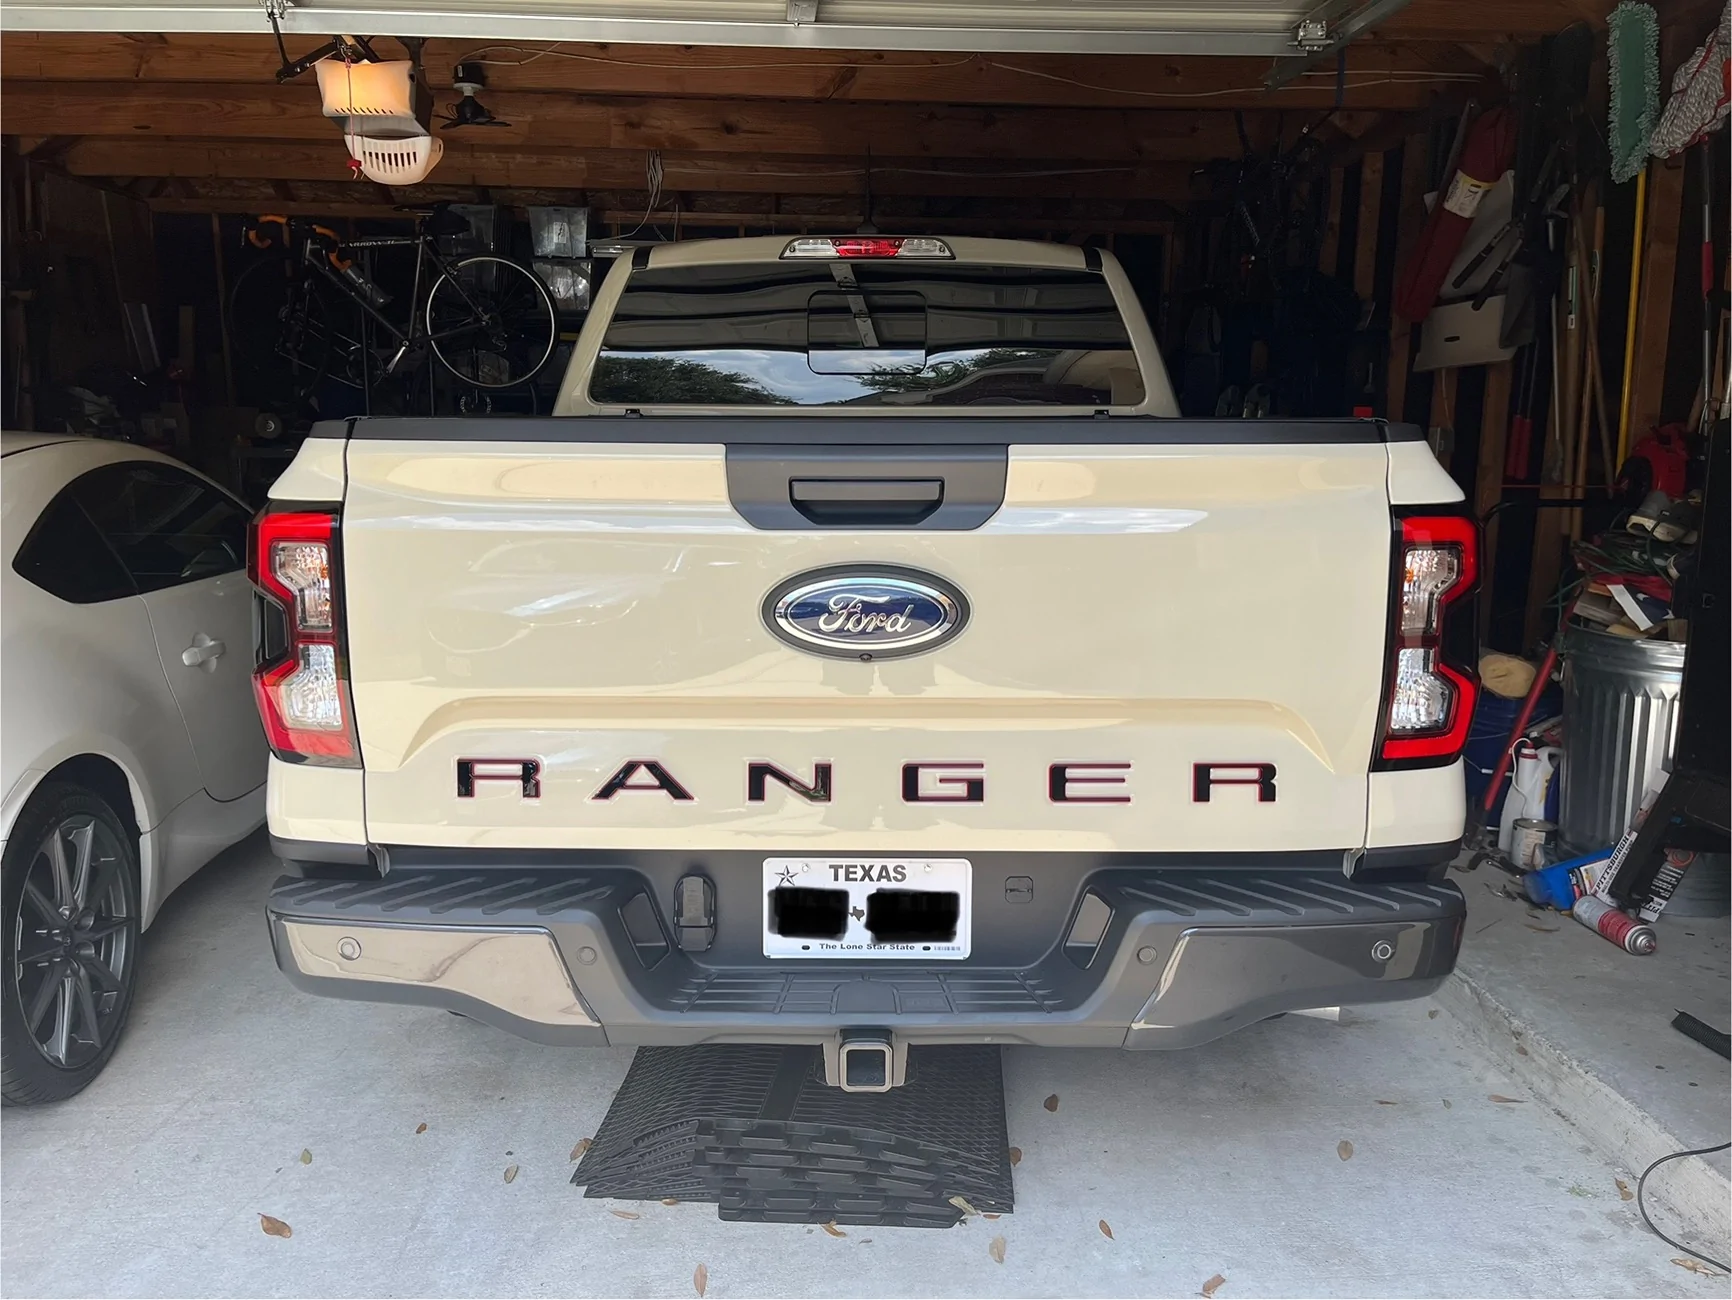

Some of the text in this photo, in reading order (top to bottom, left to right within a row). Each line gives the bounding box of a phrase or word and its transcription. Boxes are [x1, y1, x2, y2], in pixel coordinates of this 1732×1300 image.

[818, 593, 914, 632] Ford
[456, 757, 1278, 804] RANGER
[829, 864, 907, 883] TEXAS
[1596, 836, 1629, 890] PITTSBURGH
[889, 943, 915, 951] State
